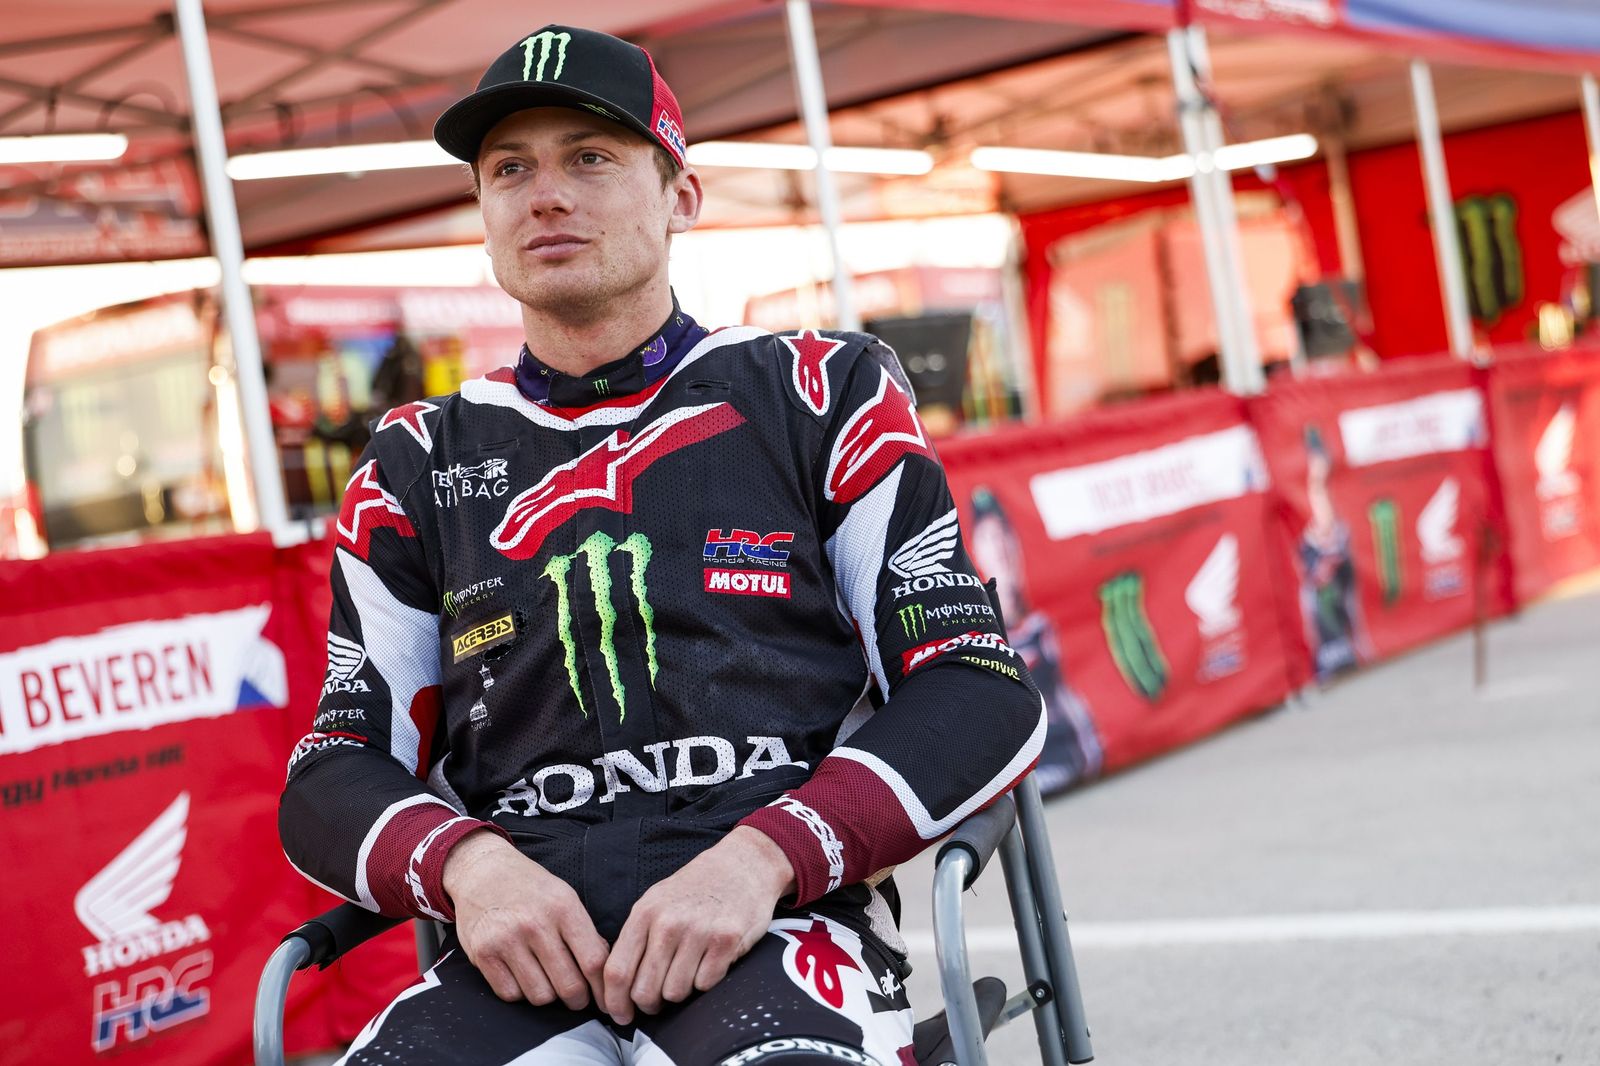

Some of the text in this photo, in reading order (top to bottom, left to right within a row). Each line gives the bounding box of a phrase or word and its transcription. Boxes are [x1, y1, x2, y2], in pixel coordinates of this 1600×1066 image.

[702, 528, 795, 561] HRC
[453, 576, 505, 604] MONSTER
[708, 571, 788, 595] MOTUL
[891, 573, 986, 602] HONDA
[925, 602, 996, 620] MONSTER
[20, 639, 215, 731] BEVEREN
[491, 735, 810, 818] HONDA
[82, 914, 212, 977] HONDA
[91, 949, 214, 1053] HRC
